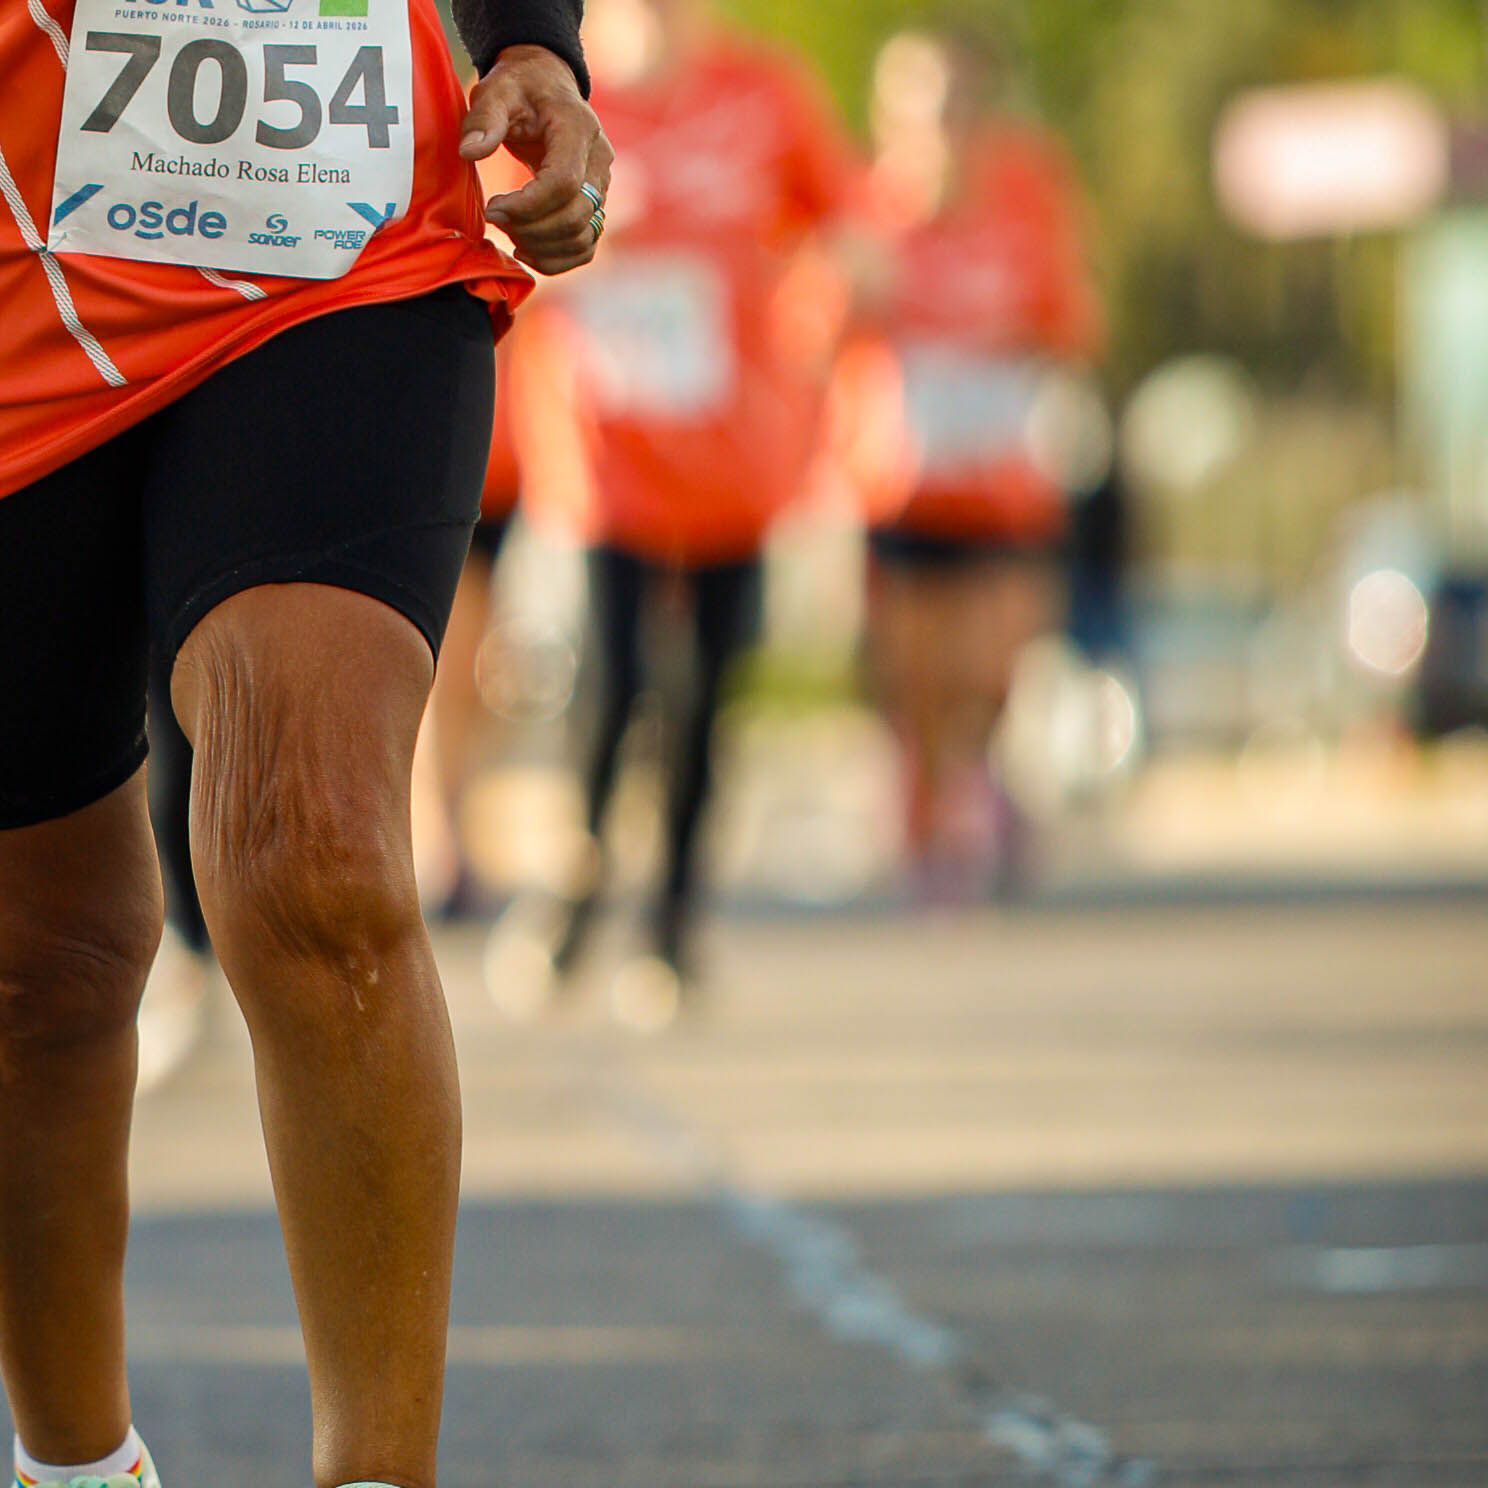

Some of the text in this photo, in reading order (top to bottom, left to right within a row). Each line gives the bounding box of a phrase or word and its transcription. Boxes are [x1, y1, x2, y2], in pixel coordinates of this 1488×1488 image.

[114, 9, 158, 20] PUERTO
[162, 12, 199, 24] NORTE
[202, 16, 230, 27] 2026
[242, 19, 280, 29] ROSARIO
[289, 20, 299, 29] 12
[302, 20, 313, 30] DE
[316, 20, 343, 31] ABRIL
[346, 21, 368, 31] 2026
[80, 31, 399, 150] 7054
[130, 151, 351, 184] Machado Rosa Elena
[107, 200, 228, 240] osde
[314, 230, 366, 240] POWER
